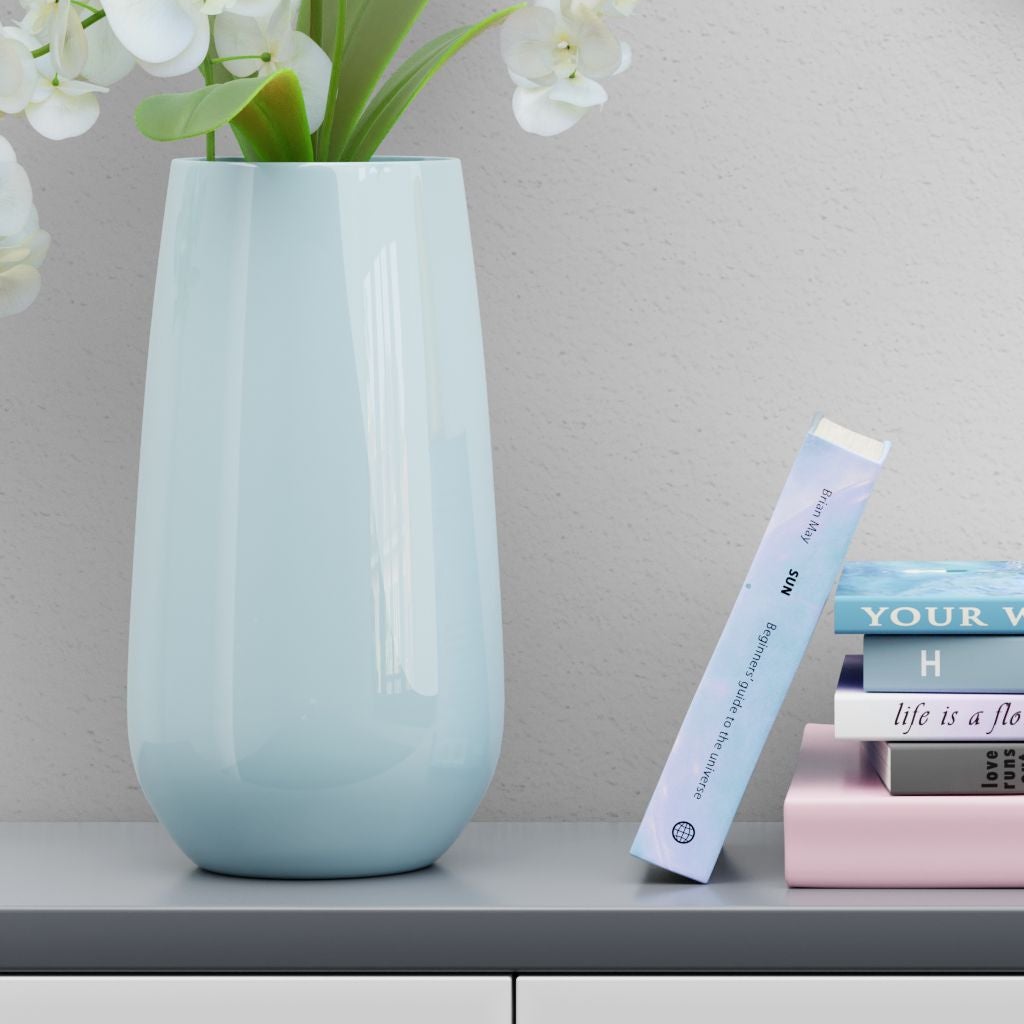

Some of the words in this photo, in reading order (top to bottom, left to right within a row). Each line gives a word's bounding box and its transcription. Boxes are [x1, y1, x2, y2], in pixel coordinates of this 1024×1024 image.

[813, 488, 833, 518] Brian
[800, 519, 820, 545] May
[780, 568, 799, 597] SUN
[860, 606, 989, 627] YOUR
[729, 679, 749, 713] guide
[723, 715, 735, 729] to
[893, 702, 930, 735] life
[940, 706, 959, 726] is
[968, 710, 983, 726] a
[713, 730, 729, 751] the
[693, 752, 720, 800] universe
[981, 750, 999, 788] love
[1003, 748, 1016, 790] runs
